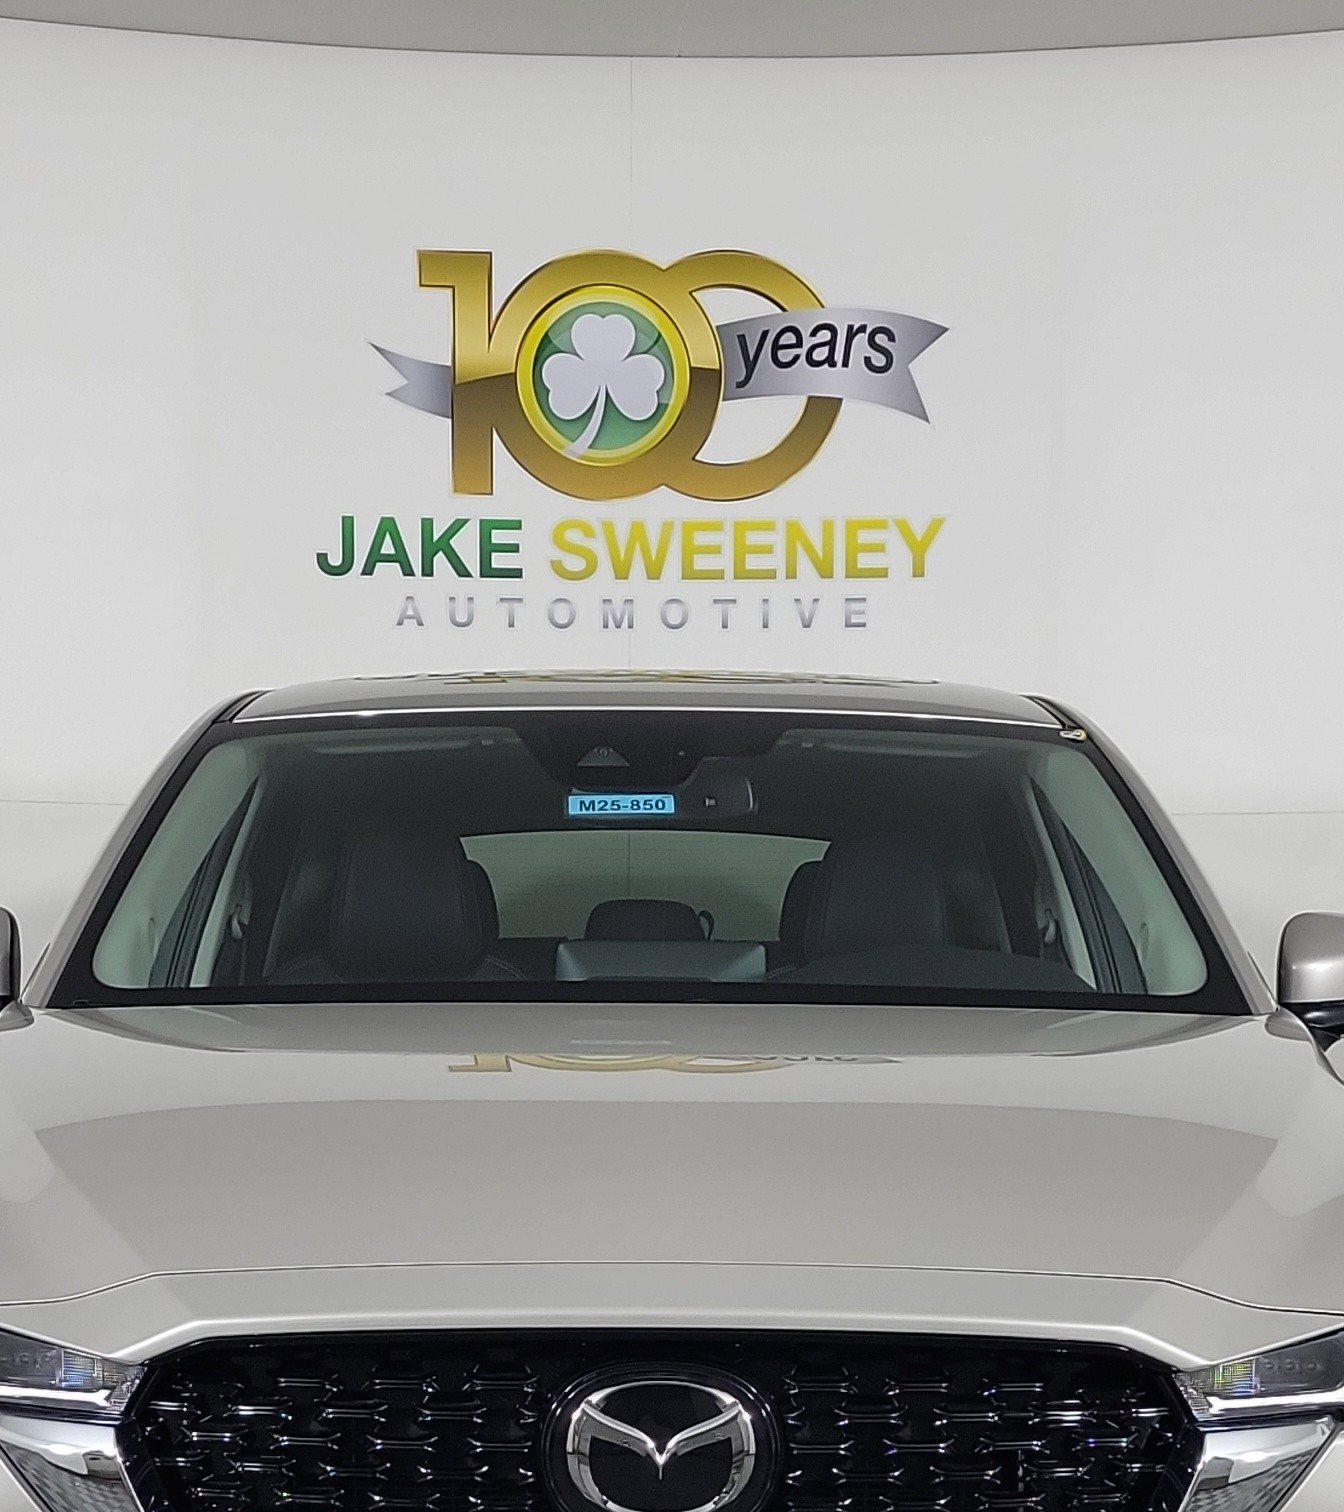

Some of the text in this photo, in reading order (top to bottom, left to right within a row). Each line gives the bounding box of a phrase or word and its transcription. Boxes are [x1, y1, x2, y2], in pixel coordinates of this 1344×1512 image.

[416, 248, 897, 501] 100 years
[315, 516, 947, 582] JAKE SWEENEY
[396, 596, 869, 631] AUTOMOTIVE
[579, 799, 666, 812] M25-850
